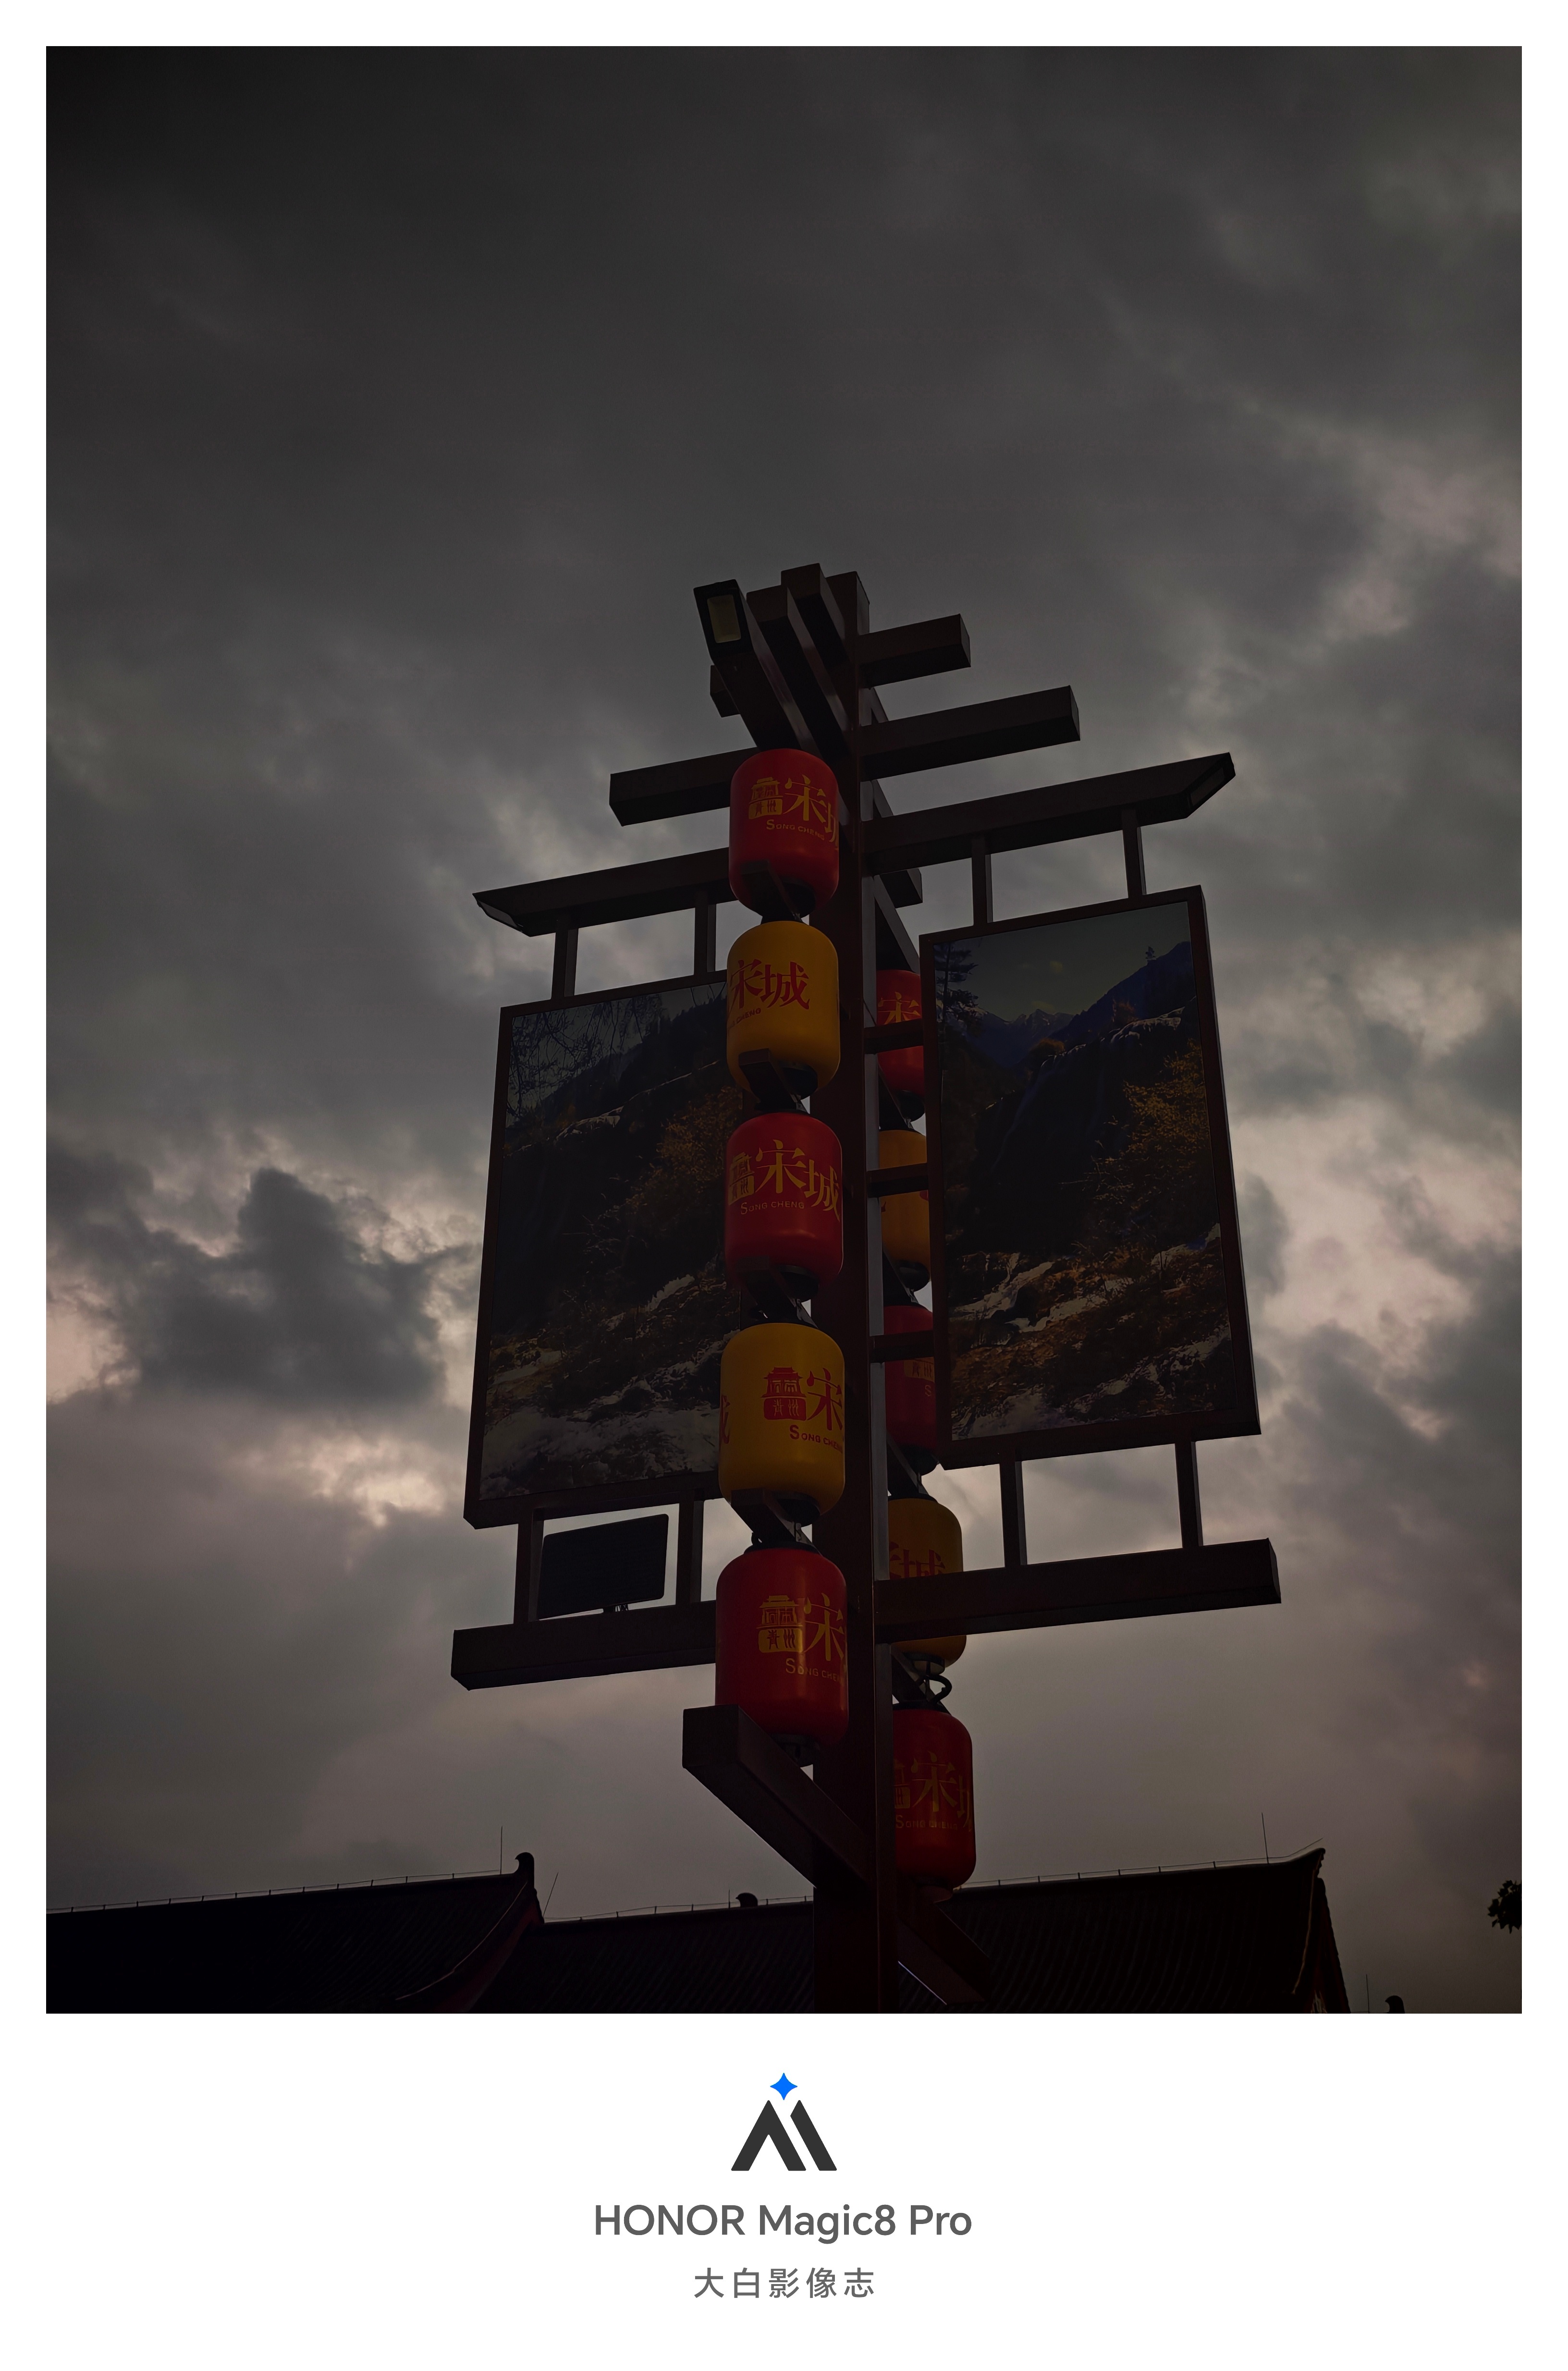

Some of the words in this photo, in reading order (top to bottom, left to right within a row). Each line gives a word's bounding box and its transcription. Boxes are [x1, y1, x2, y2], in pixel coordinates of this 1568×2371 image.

[728, 958, 810, 1018] 宋城
[755, 1139, 840, 1222] 宋城
[740, 1202, 768, 1215] SONG
[771, 1200, 805, 1210] CHENG
[789, 1424, 821, 1443] SONG
[785, 1657, 819, 1677] SONG
